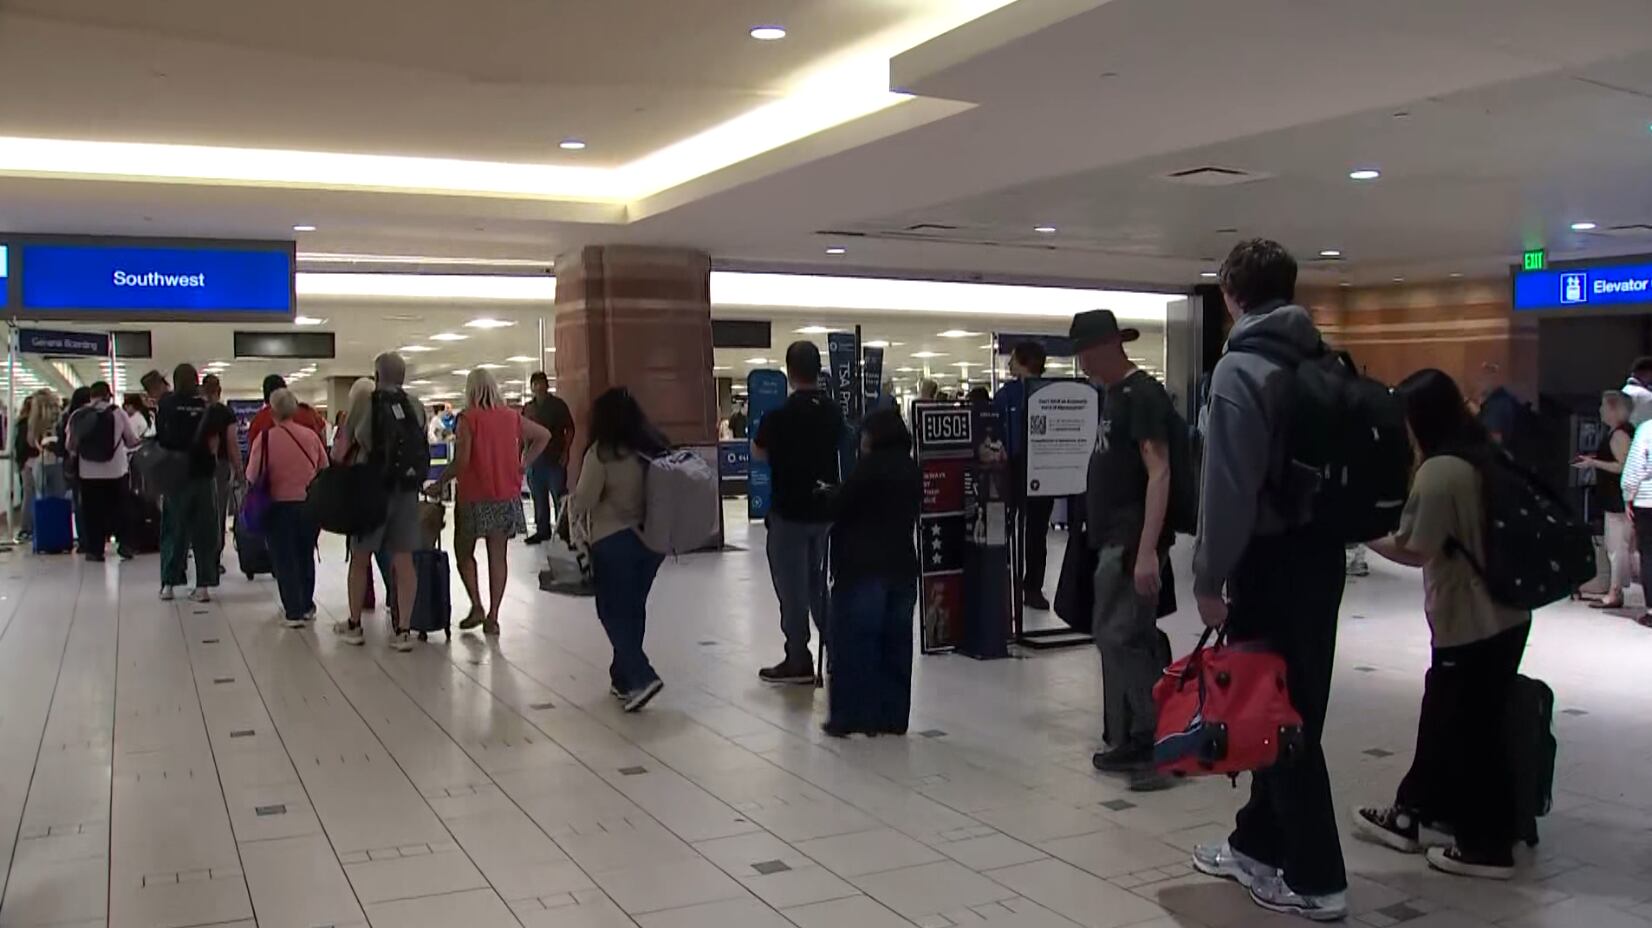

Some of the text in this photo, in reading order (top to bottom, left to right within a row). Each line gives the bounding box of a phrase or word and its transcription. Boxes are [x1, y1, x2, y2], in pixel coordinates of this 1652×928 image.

[1525, 251, 1544, 270] EXIT
[113, 271, 205, 288] Southwest
[1593, 279, 1649, 294] Elevator
[839, 361, 851, 387] TSA
[933, 415, 962, 438] USO
